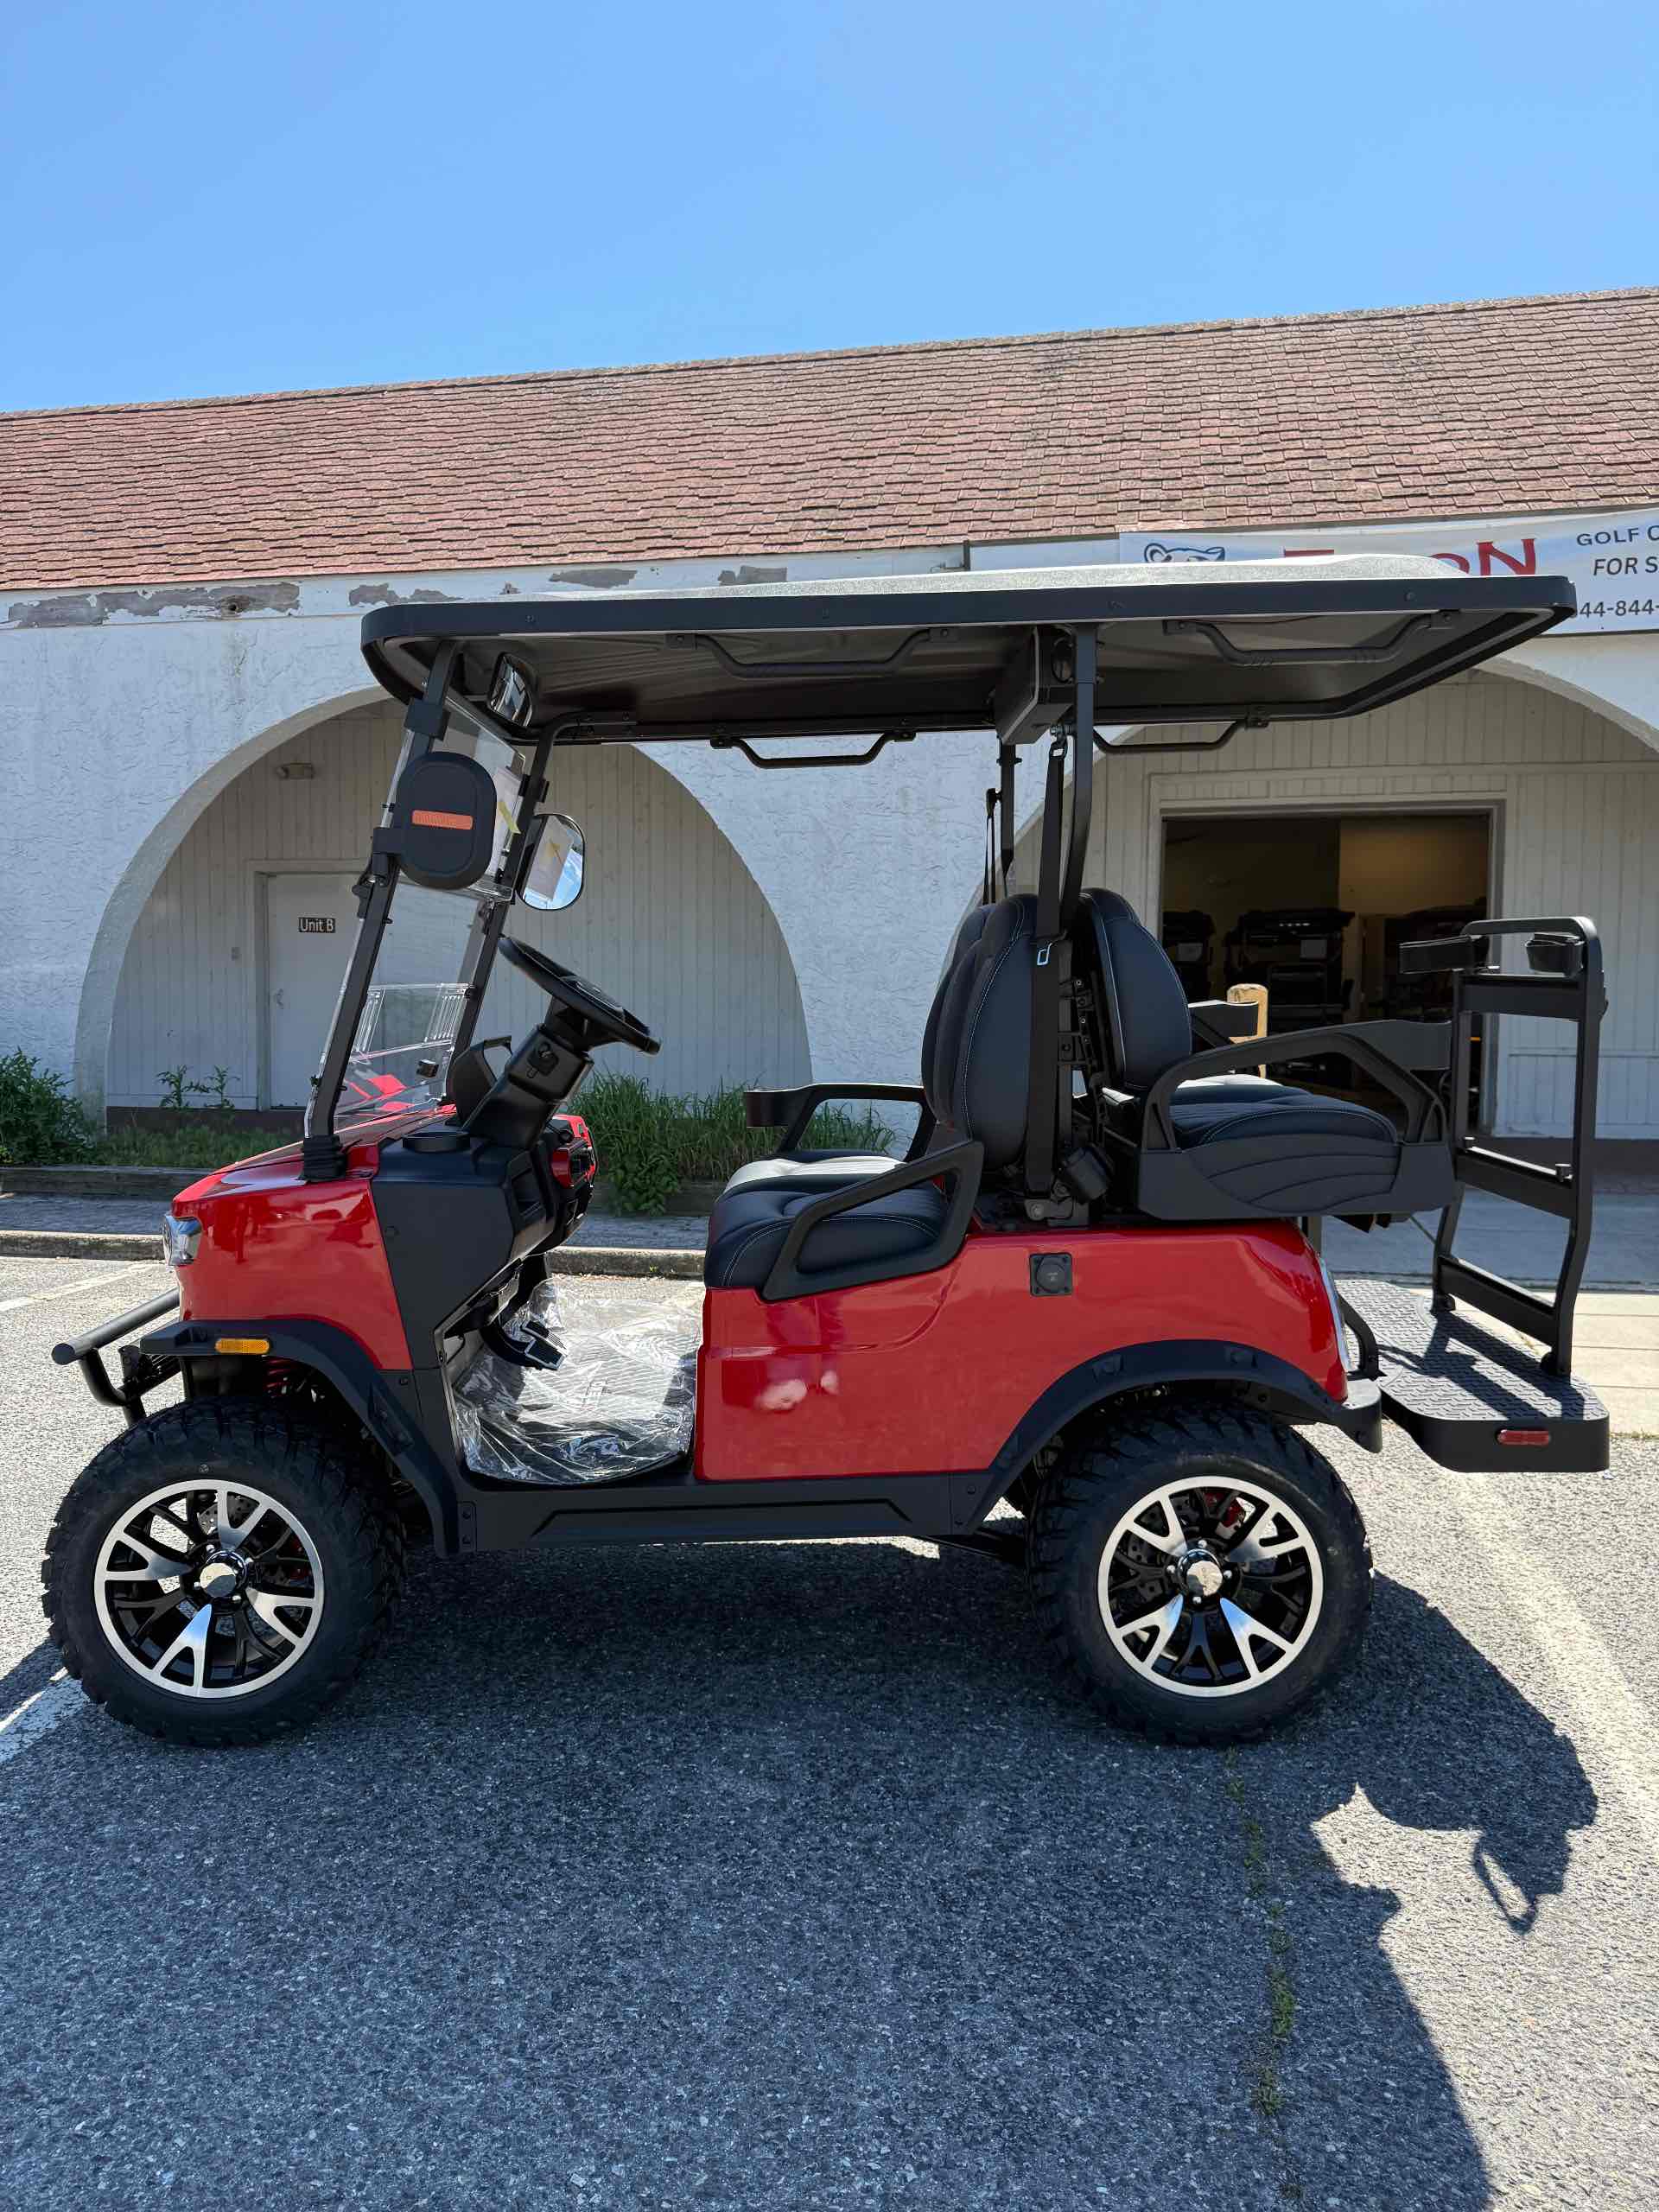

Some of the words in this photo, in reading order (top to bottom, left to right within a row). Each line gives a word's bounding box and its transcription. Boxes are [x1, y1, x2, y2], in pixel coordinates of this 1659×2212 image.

[1576, 527, 1639, 546] GOLF
[1592, 557, 1638, 576] FOR
[1578, 599, 1659, 618] 44-844-
[300, 918, 324, 932] Unit
[327, 918, 334, 931] B
